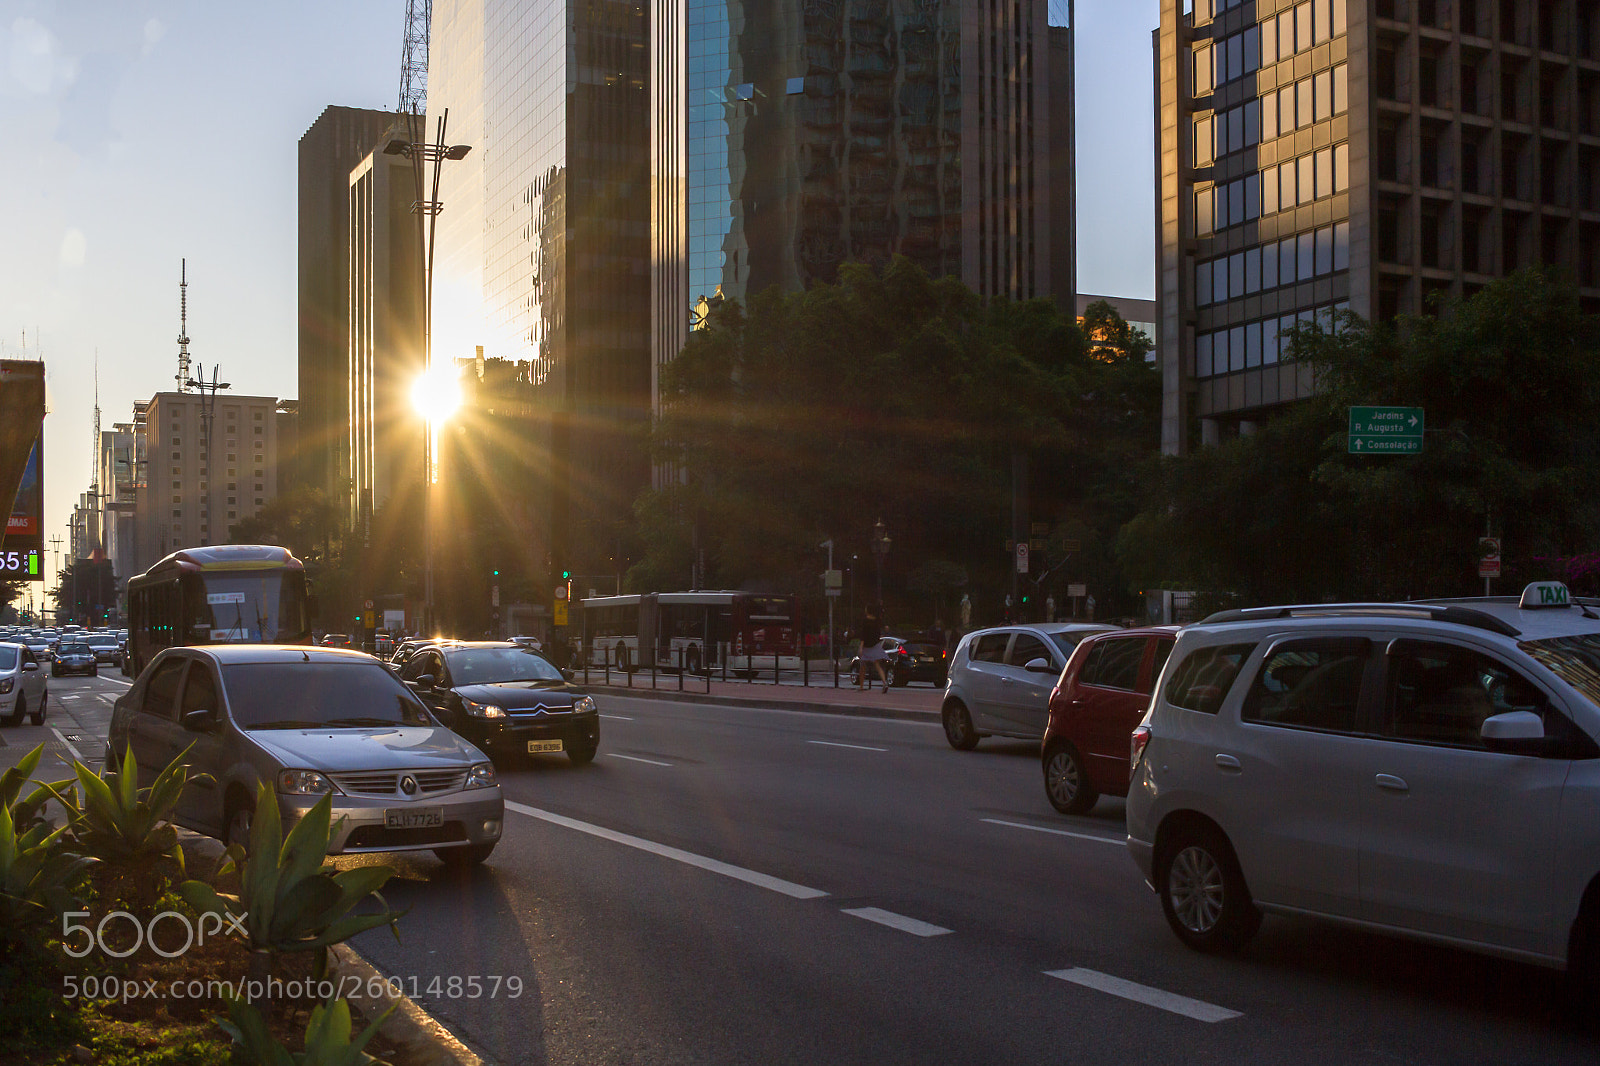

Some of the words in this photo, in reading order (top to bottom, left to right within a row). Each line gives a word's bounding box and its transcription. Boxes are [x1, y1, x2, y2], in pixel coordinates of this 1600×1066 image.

[1372, 411, 1404, 420] Jardins
[1368, 423, 1404, 434] Augusta
[1368, 440, 1418, 451] Consolação
[1537, 586, 1567, 604] TAXI
